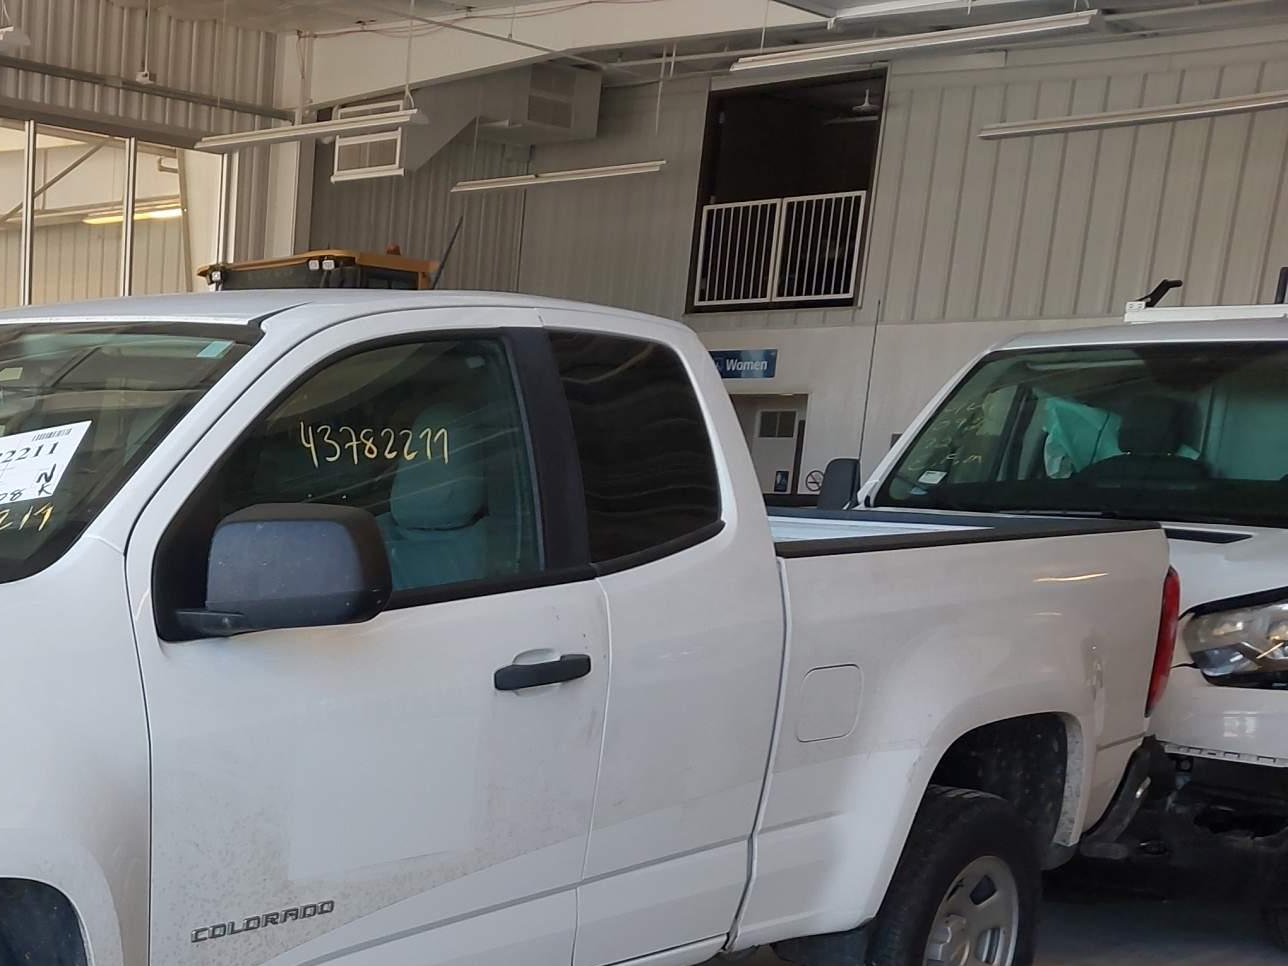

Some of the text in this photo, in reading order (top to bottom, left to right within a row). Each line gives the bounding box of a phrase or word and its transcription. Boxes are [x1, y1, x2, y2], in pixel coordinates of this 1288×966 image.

[725, 358, 768, 371] Women
[300, 421, 449, 468] 43782211
[190, 899, 335, 943] COLORADO
